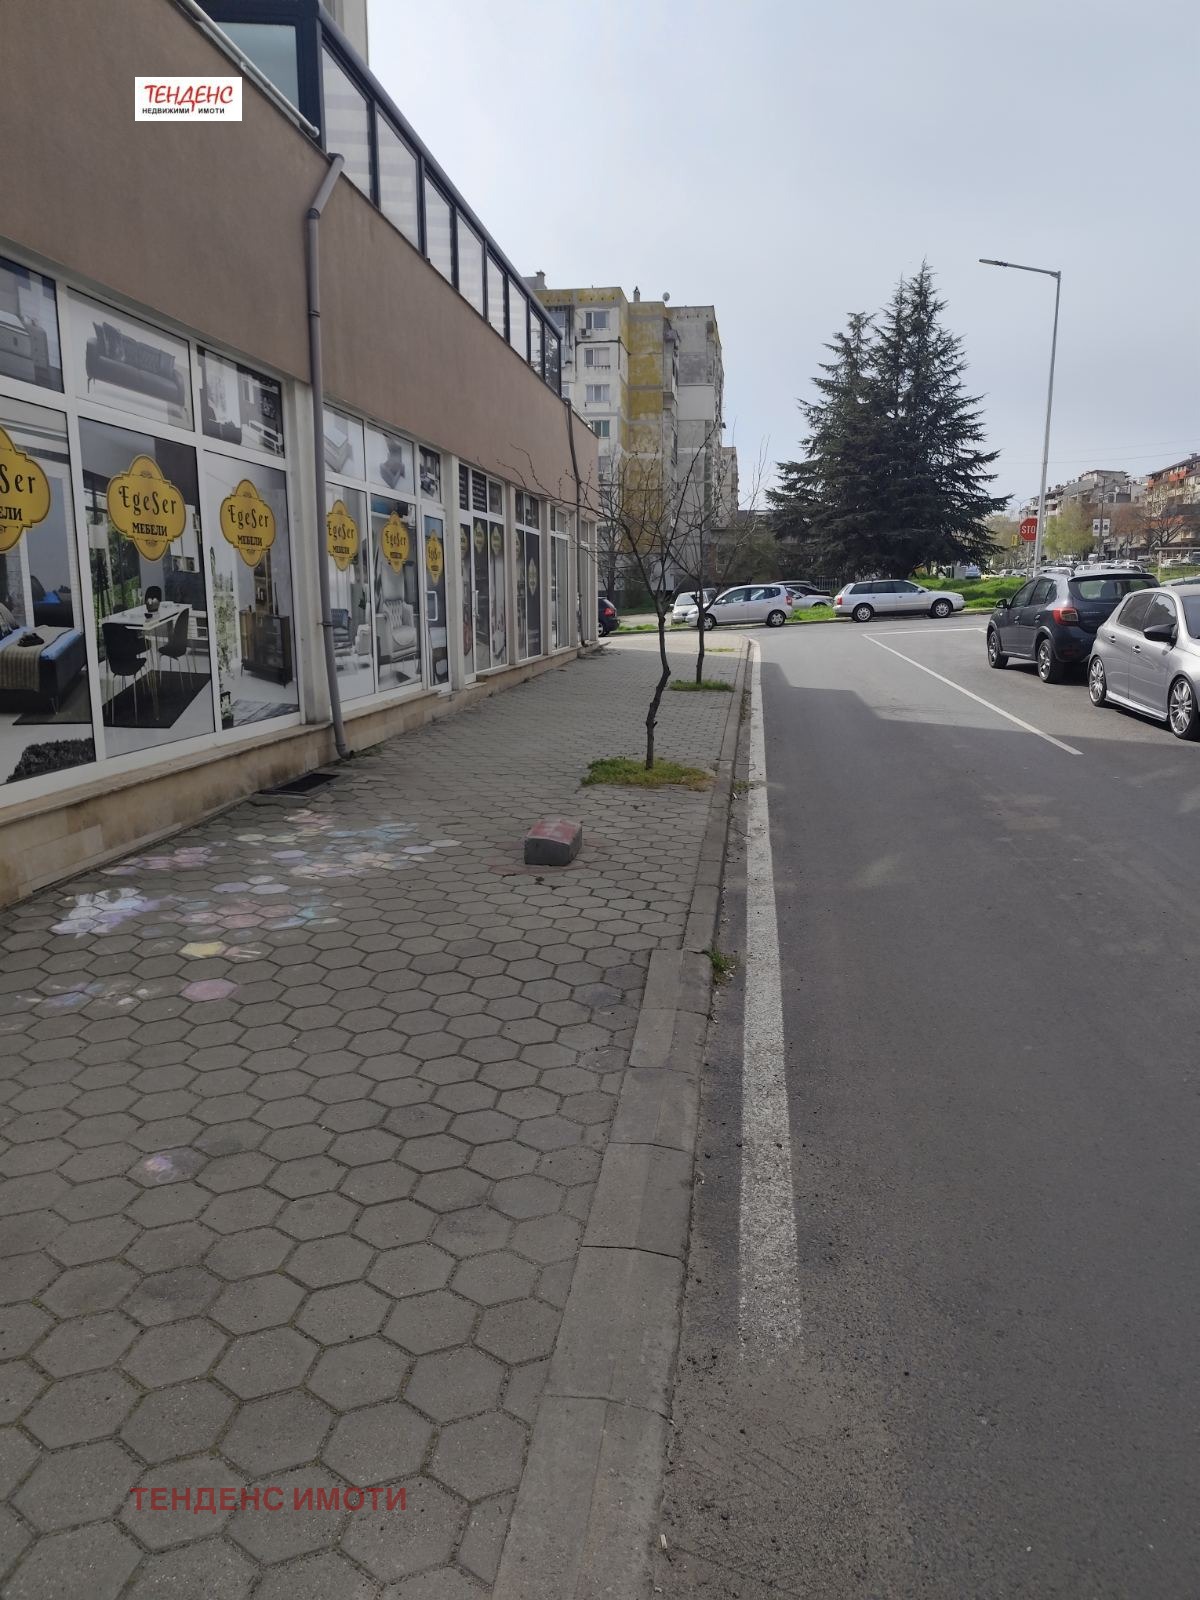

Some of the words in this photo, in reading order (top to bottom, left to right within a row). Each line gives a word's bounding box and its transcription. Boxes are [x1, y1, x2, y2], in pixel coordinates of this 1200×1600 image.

[118, 485, 177, 516] EgeSer
[228, 504, 269, 530] EgeSer
[132, 522, 168, 537] МЕБЕЛИ
[1021, 525, 1036, 534] STO
